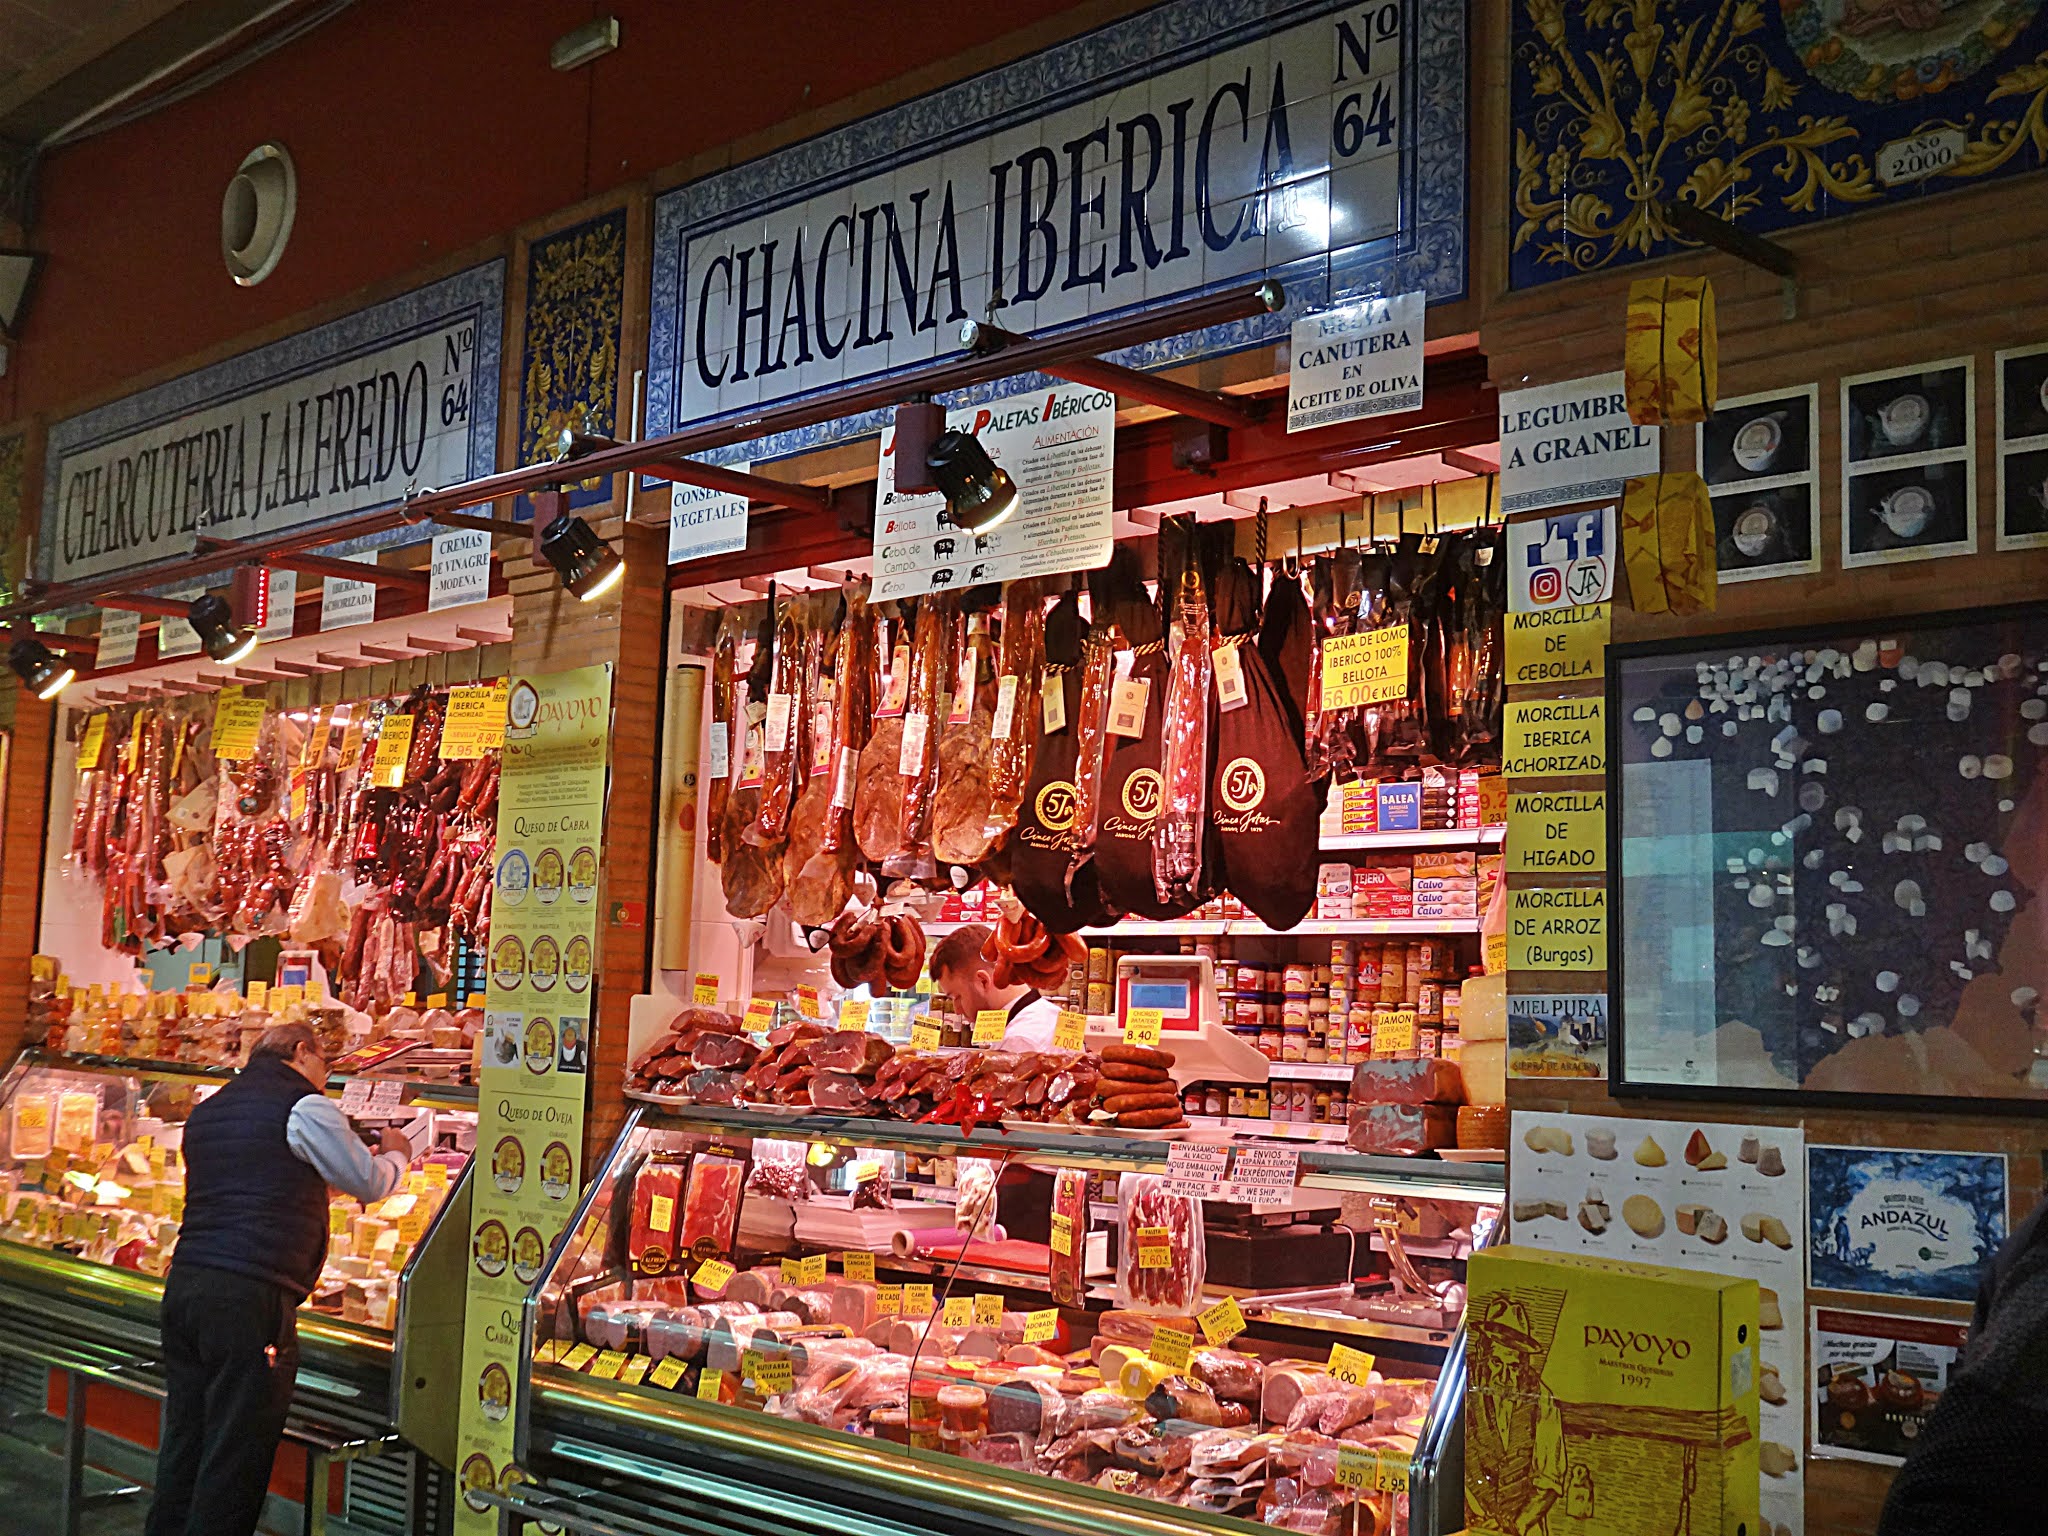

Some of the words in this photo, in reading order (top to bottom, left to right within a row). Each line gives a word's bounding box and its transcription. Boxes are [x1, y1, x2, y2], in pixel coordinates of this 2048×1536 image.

[1333, 80, 1397, 159] 64
[696, 180, 968, 388] CHACINA
[990, 61, 1309, 309] IBERICA
[1299, 330, 1411, 370] CANUTERA
[1342, 364, 1362, 380] EN
[1290, 388, 1341, 412] ACEITE
[1345, 384, 1365, 400] DE
[1369, 374, 1419, 395] OLIVA
[442, 380, 468, 427] 64
[972, 409, 1039, 438] PALETAS
[1042, 392, 1112, 423] IBÉRICOS
[1503, 394, 1626, 434] LEGUMBR
[1033, 425, 1099, 449] ALIMENTACIÓN
[1508, 446, 1525, 470] A
[1533, 425, 1650, 463] GRANEL
[63, 416, 247, 565] CHARCUTERIA
[673, 487, 728, 508] CONSER
[673, 501, 745, 529] VEGETALES
[883, 520, 917, 534] Bellota
[440, 533, 483, 555] CREMAS
[882, 546, 906, 559] Cebo
[909, 544, 921, 554] de
[432, 562, 442, 576] DE
[445, 552, 489, 572] VINAGRE
[884, 561, 916, 575] Campo
[881, 581, 906, 593] Cebo
[1514, 606, 1602, 629] MORCILLA
[1324, 637, 1356, 653] CAÑA
[1360, 637, 1373, 647] DE
[1376, 628, 1407, 644] LOMO
[1545, 635, 1566, 652] DE
[1330, 651, 1370, 669] IBERICO
[1375, 645, 1401, 660] 100%
[1343, 666, 1387, 684] BELLOTA
[1518, 660, 1592, 680] CEBOLLA
[451, 691, 490, 699] MORCILLA
[1382, 684, 1406, 698] KILO
[453, 702, 485, 710] IBERICA
[1515, 705, 1599, 723] MORCILLA
[385, 719, 411, 728] LOMITO
[382, 731, 409, 740] IBERICO
[476, 733, 496, 744] 8.90
[1523, 730, 1591, 748] IBERICA
[389, 744, 398, 752] DE
[445, 744, 472, 756] 7.95
[376, 756, 404, 765] BELLOTA
[1381, 794, 1414, 805] BALEA
[1481, 791, 1507, 810] 9.2
[1515, 796, 1604, 813] MORCILLA
[1240, 810, 1280, 833] Jotas
[1546, 823, 1568, 840] DE
[1523, 850, 1595, 866] HIGADO
[1354, 873, 1384, 885] TEJERO
[1417, 880, 1443, 889] Calvo
[1417, 893, 1442, 903] Calvo
[1515, 892, 1604, 909] MORCILLA
[1417, 906, 1442, 915] Calvo
[1514, 920, 1535, 935] DE
[1542, 918, 1601, 935] ARROZ
[1526, 945, 1594, 967] (Burgos)
[1513, 1000, 1549, 1014] MIEL
[1552, 999, 1603, 1017] PURA
[1380, 1014, 1411, 1025] JAMON
[1127, 1031, 1151, 1040] 8.40
[1380, 1025, 1410, 1034] SERRANO
[1179, 1144, 1219, 1154] ENVASAMOS
[1254, 1150, 1281, 1159] ENVIOS
[1166, 1161, 1185, 1169] NOUS
[1186, 1162, 1224, 1172] EMBALLONS
[1242, 1158, 1266, 1166] ESPAÑA
[1243, 1168, 1286, 1178] EXPÉDITION
[1177, 1181, 1186, 1189] WE
[1187, 1182, 1205, 1191] PACK
[1246, 1187, 1258, 1195] WE
[1259, 1188, 1276, 1196] SHIP
[1182, 1190, 1208, 1198] VACUUM
[1861, 1210, 1949, 1237] ANDAZUL
[704, 1260, 731, 1275] SALAMI
[1033, 1312, 1051, 1320] LOMO
[1204, 1301, 1228, 1319] MORCON
[1209, 1310, 1229, 1325] IBERICO
[944, 1316, 962, 1326] 4.65
[976, 1314, 994, 1324] 2.45
[1026, 1320, 1055, 1330] ADOBADO
[1159, 1328, 1182, 1338] MORCON
[756, 1372, 790, 1380] CATALANA
[1329, 1367, 1356, 1384] 4.00
[1621, 1373, 1651, 1389] 1997
[1340, 1470, 1362, 1485] 9.80
[1380, 1476, 1405, 1491] 2.95
